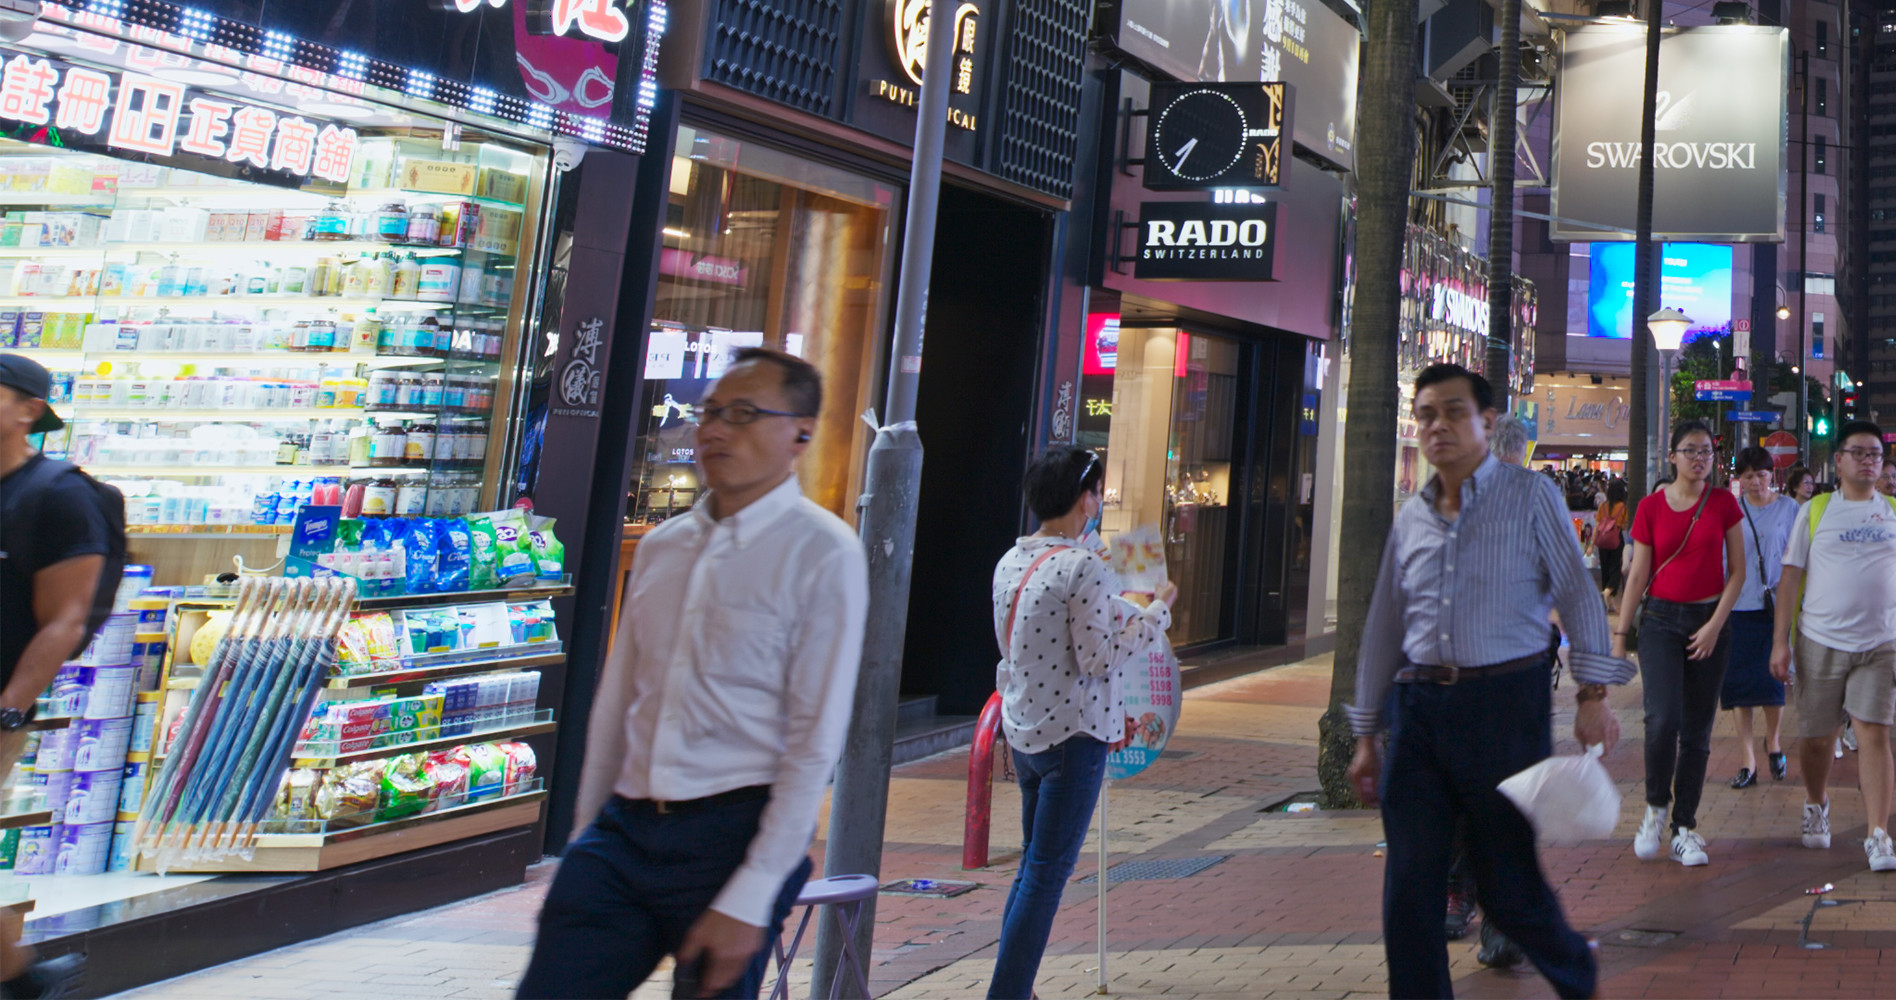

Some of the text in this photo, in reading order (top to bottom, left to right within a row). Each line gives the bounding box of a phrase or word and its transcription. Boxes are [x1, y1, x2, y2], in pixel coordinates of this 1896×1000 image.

[0, 54, 111, 135] 註冊
[880, 79, 976, 131] PUYI ICAL
[1249, 129, 1278, 137] RADO
[1586, 141, 1756, 169] SWAROVSKI
[1145, 219, 1267, 247] RADO
[1143, 248, 1264, 260] SWITZERLAND
[1565, 396, 1604, 420] Lane
[1149, 666, 1171, 678] $168
[1150, 679, 1172, 692] $198
[1151, 694, 1172, 706] $998
[349, 706, 375, 717] Colgate
[342, 723, 372, 735] Colgate
[340, 739, 370, 751] Colgate
[1123, 750, 1146, 765] 3553
